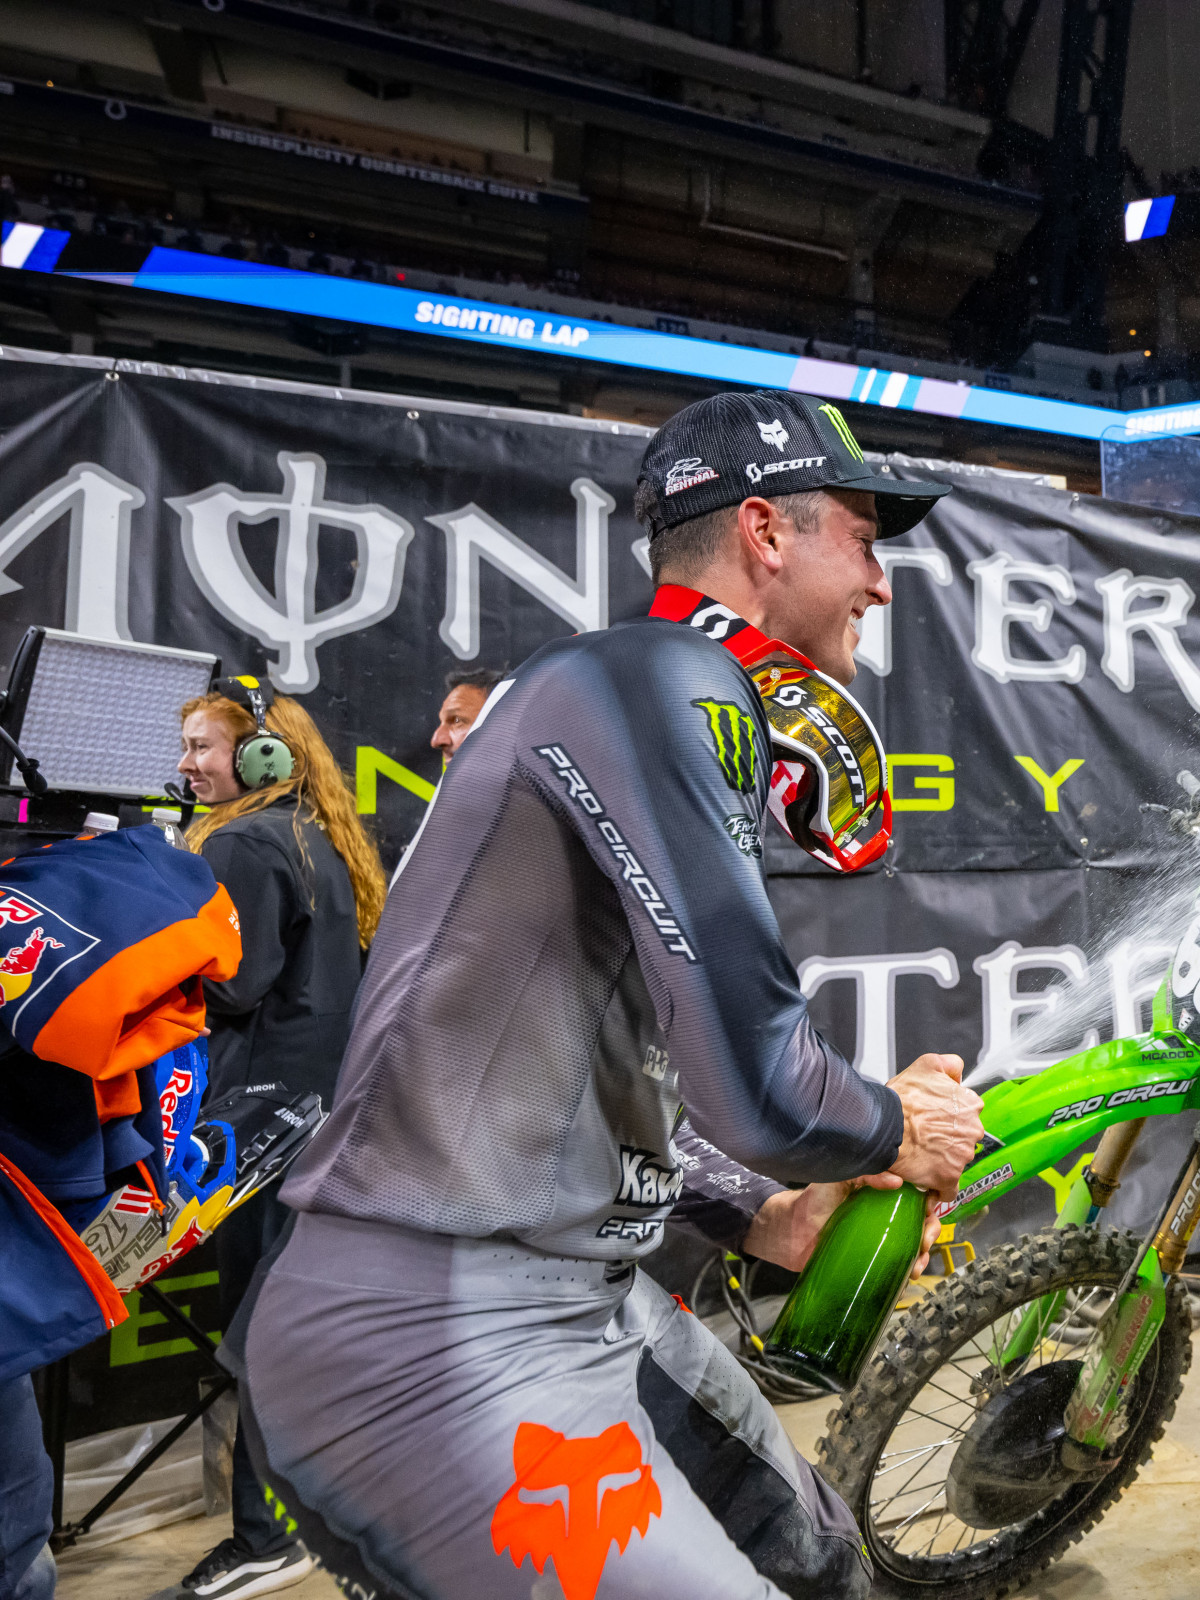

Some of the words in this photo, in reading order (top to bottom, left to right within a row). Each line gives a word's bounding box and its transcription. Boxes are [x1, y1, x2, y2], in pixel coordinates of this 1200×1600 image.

[487, 180, 539, 204] SUITE
[414, 301, 536, 340] SIGHTING
[540, 322, 589, 347] LAP
[762, 456, 827, 475] SCOTT
[665, 468, 719, 496] RENTHAL
[800, 706, 866, 808] SCOTT
[538, 746, 603, 815] PRO
[598, 820, 696, 961] CIRCUIT
[1141, 1051, 1194, 1062] MCADOO
[246, 1083, 275, 1094] AIROH
[274, 1107, 306, 1129] AIROH
[1046, 1097, 1103, 1128] PRO
[1170, 1192, 1195, 1236] PRO
